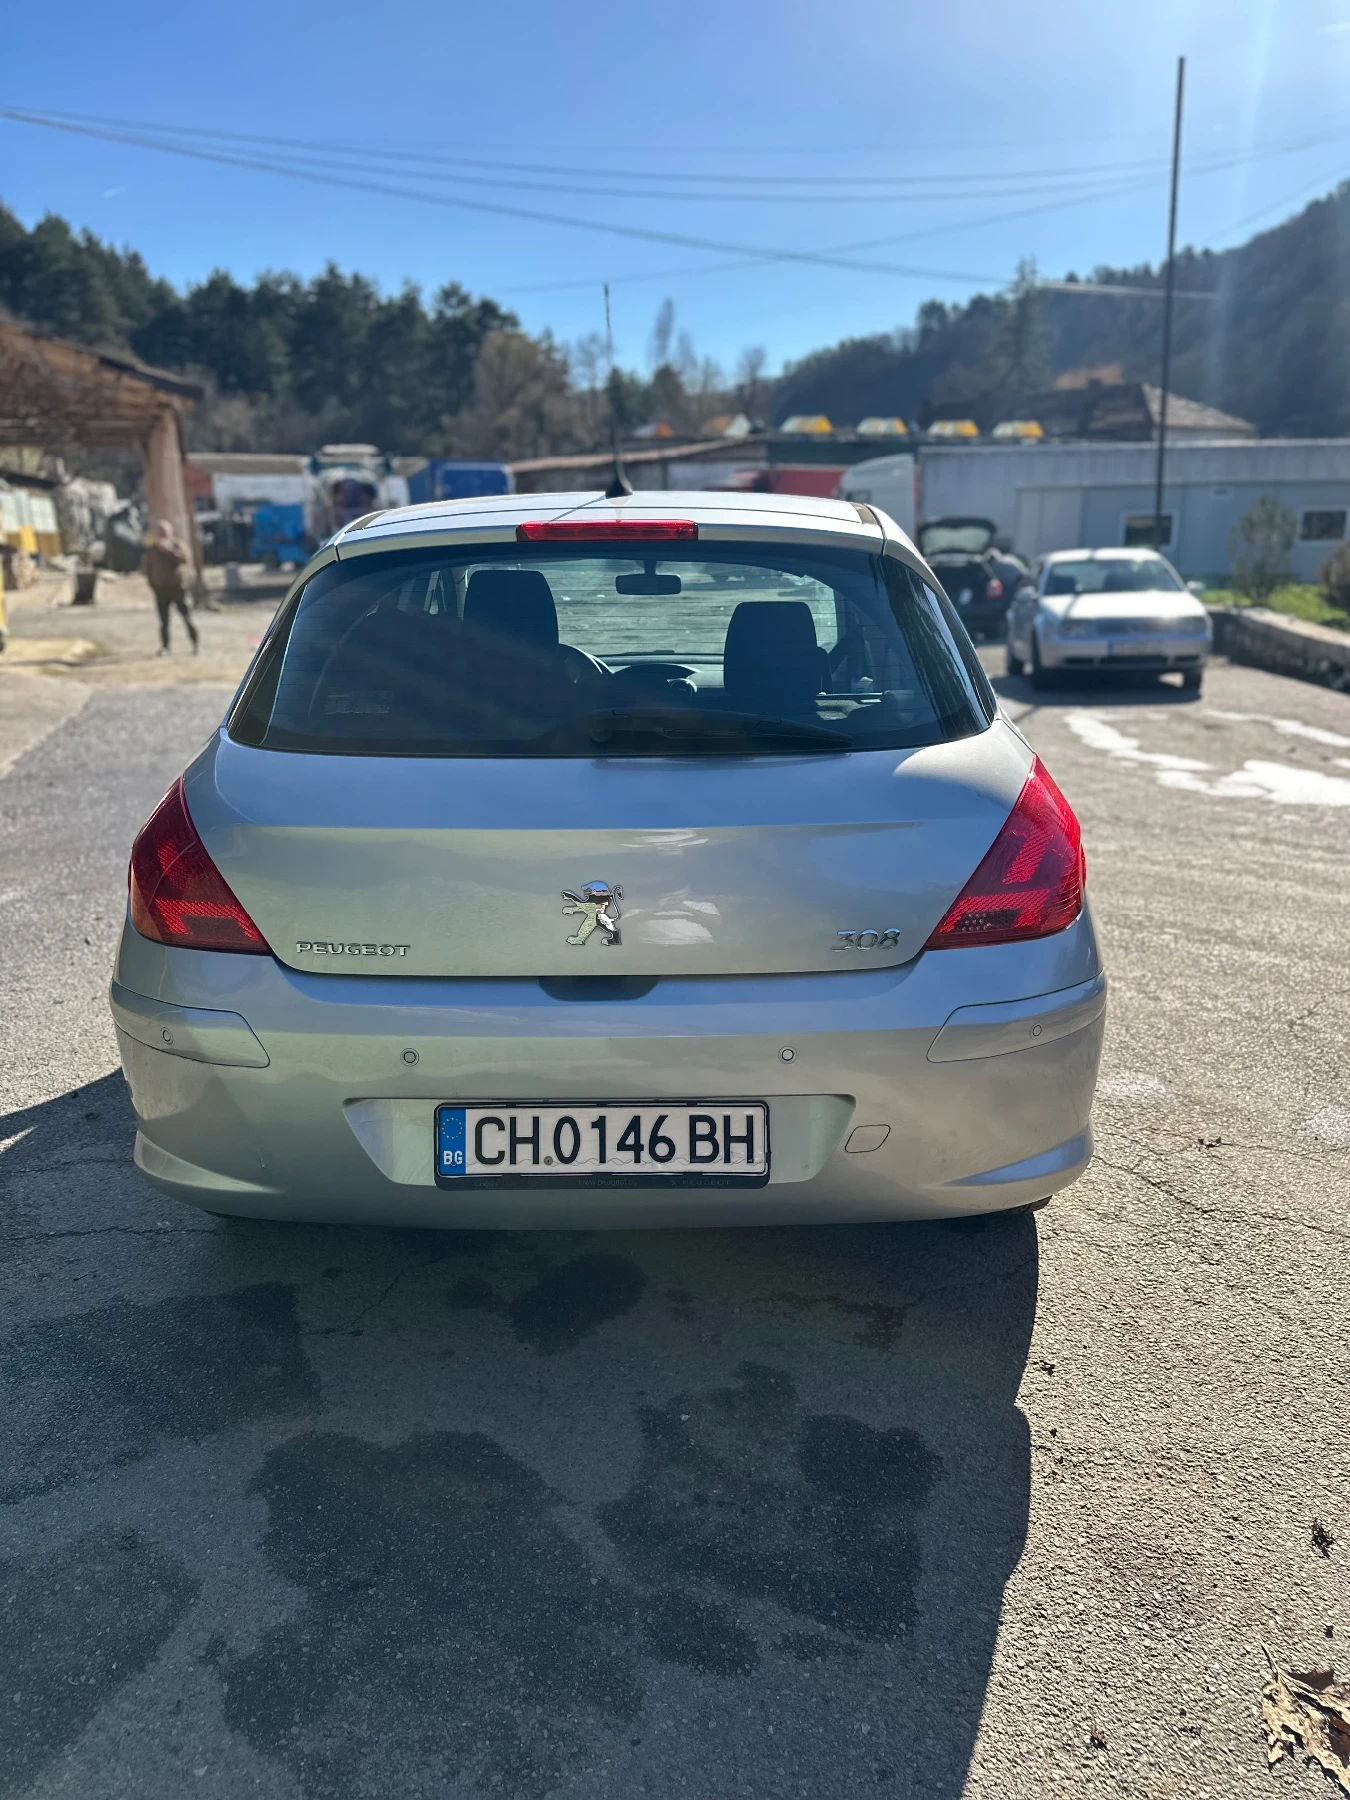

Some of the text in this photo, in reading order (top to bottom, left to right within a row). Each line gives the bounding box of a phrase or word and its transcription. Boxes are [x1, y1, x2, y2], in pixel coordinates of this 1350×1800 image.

[830, 927, 901, 952] 308
[295, 941, 411, 956] PEUGEOT
[475, 1115, 754, 1165] CH 0146 BH
[443, 1151, 463, 1165] BG
[682, 1179, 731, 1187] PEUGEOT
